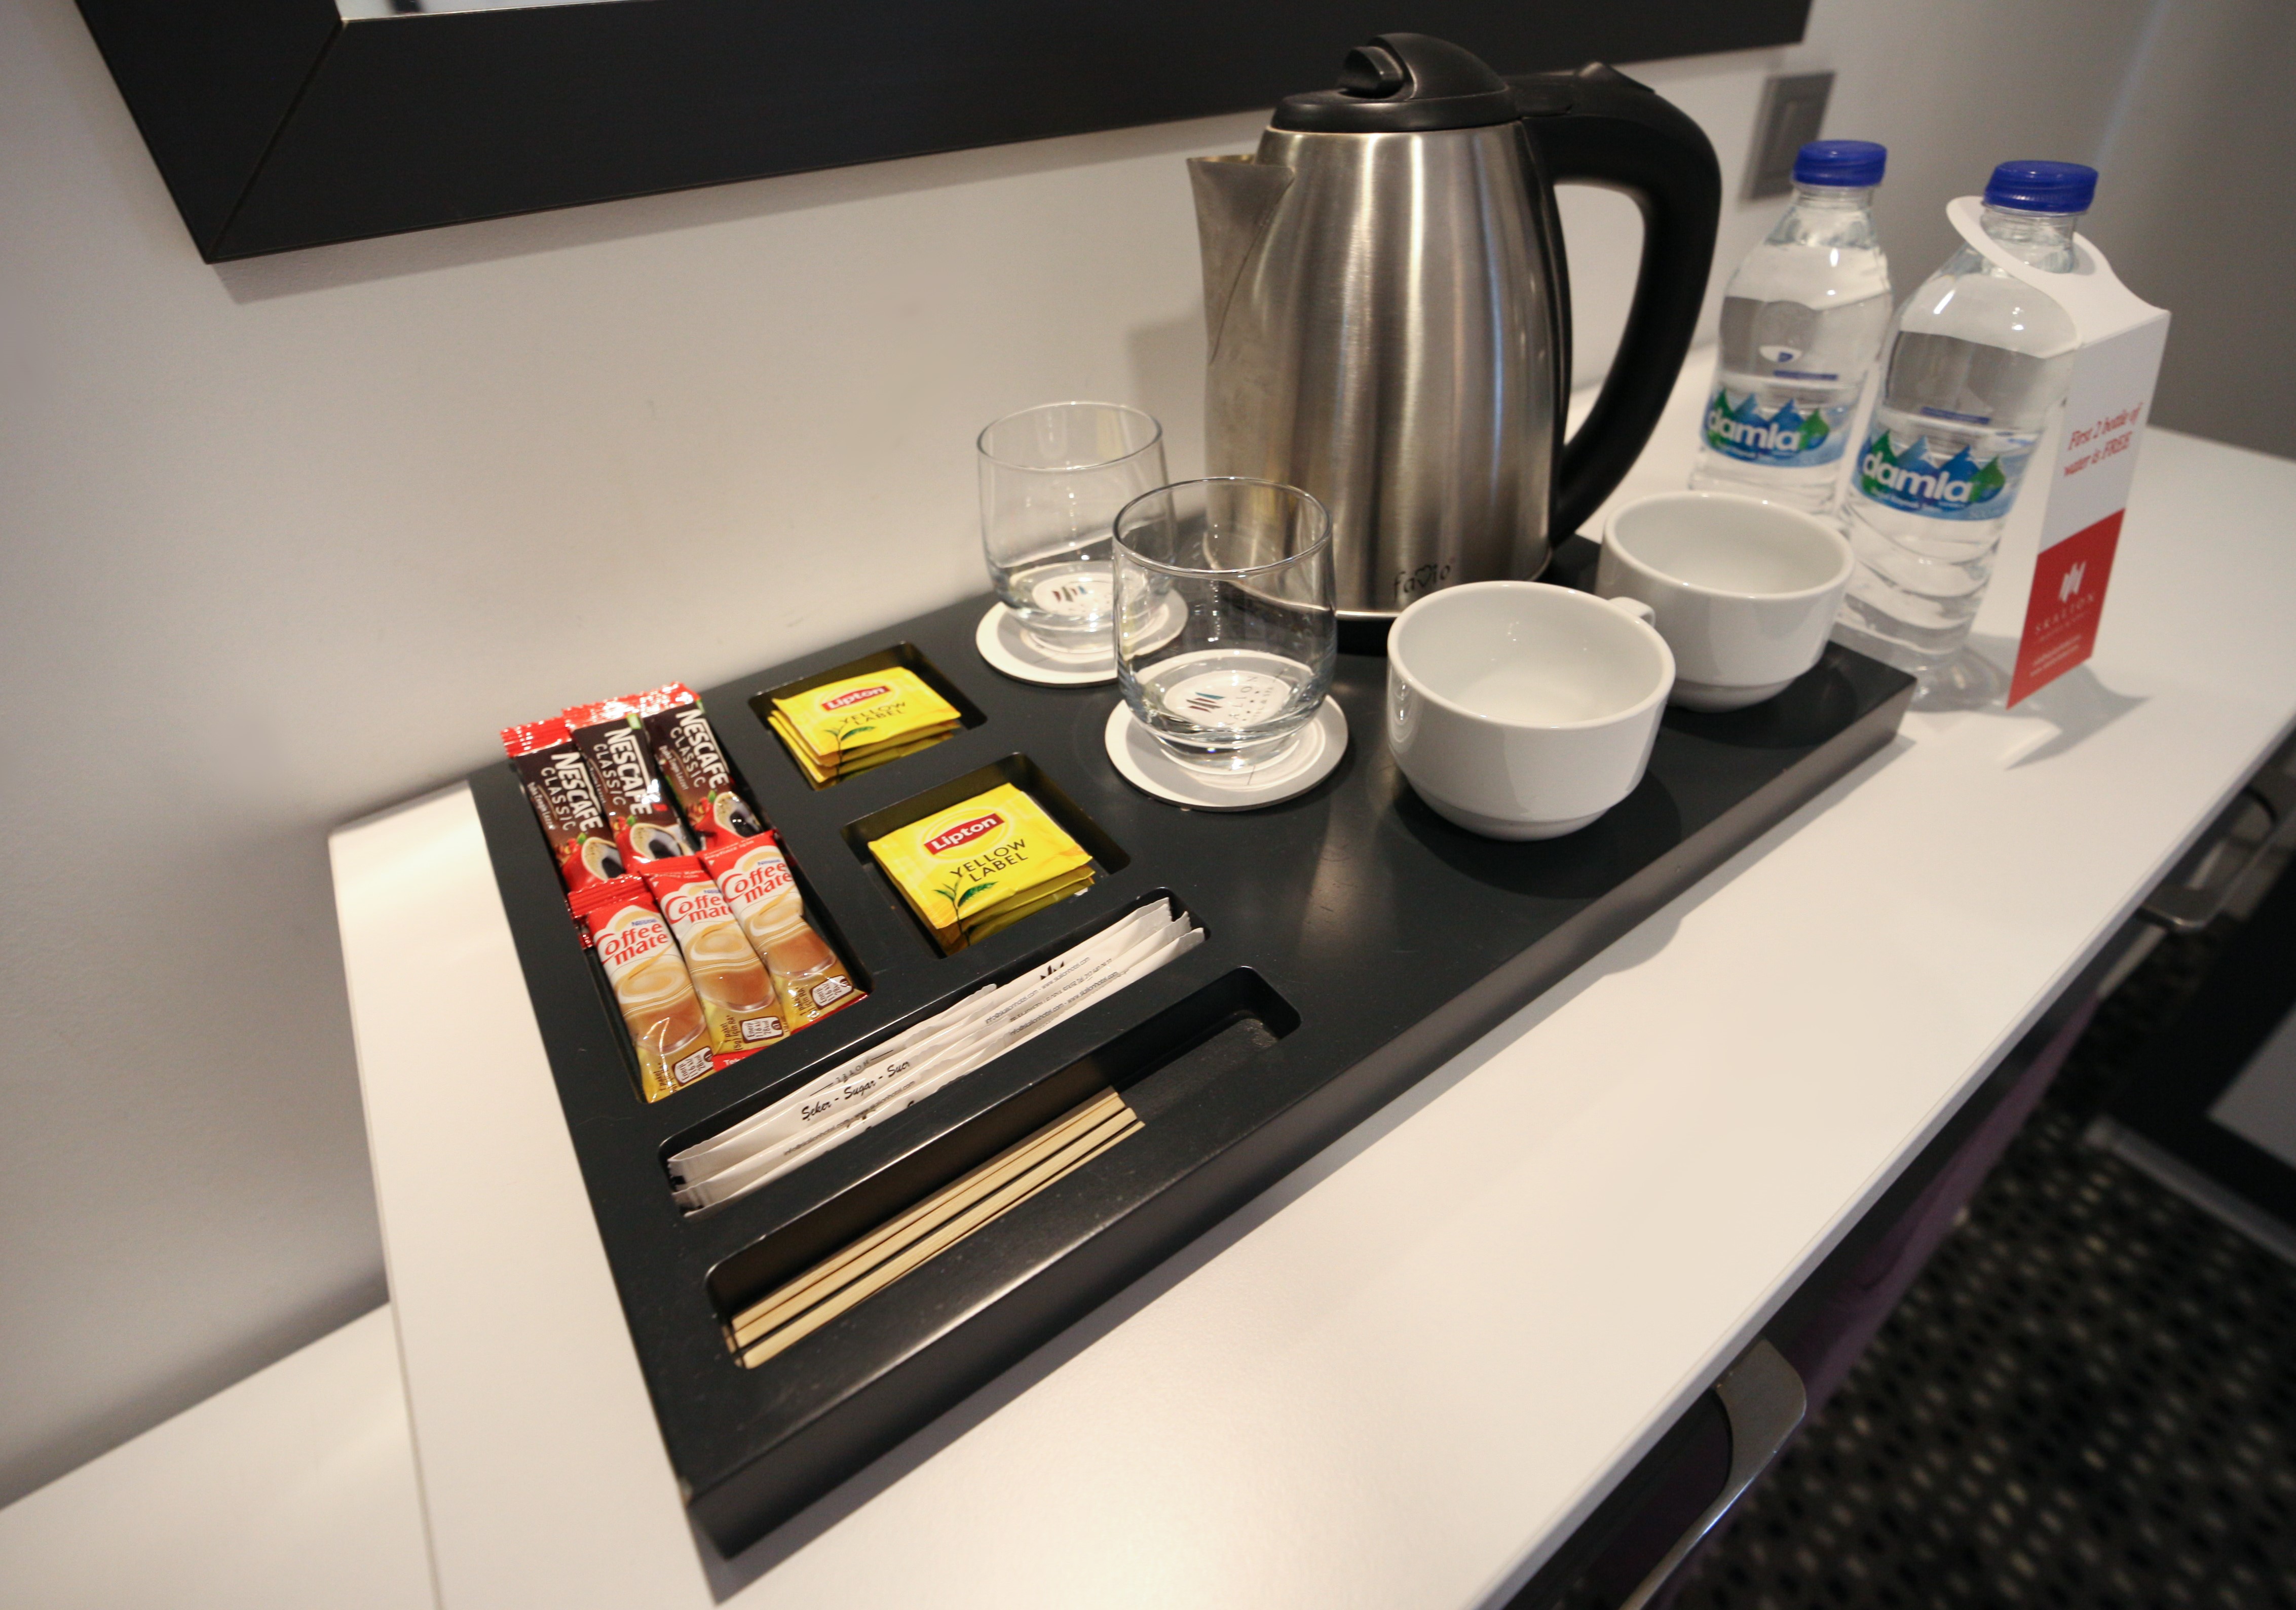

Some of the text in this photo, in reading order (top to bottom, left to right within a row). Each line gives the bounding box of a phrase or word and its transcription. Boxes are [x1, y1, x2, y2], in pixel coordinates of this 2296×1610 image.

[1708, 408, 1800, 451] damla
[1863, 451, 1973, 502] damla
[826, 687, 886, 709] Lipton
[840, 702, 906, 723] YELLOW
[854, 709, 905, 725] LABEL
[593, 743, 626, 806] CLASSIC
[670, 726, 706, 788] CLASSIC
[541, 766, 576, 831] CLASSIC
[931, 818, 997, 850] Lipton
[949, 838, 1026, 877] YELLOW
[969, 853, 1028, 882] LABEL
[722, 862, 786, 903] Coffee
[744, 872, 794, 904] mate
[665, 895, 722, 925] Coffe
[688, 905, 733, 923] mat
[595, 923, 663, 965] Coffee
[614, 933, 669, 966] mate
[802, 1101, 832, 1121] Şeker
[844, 1080, 877, 1100] Sugar
